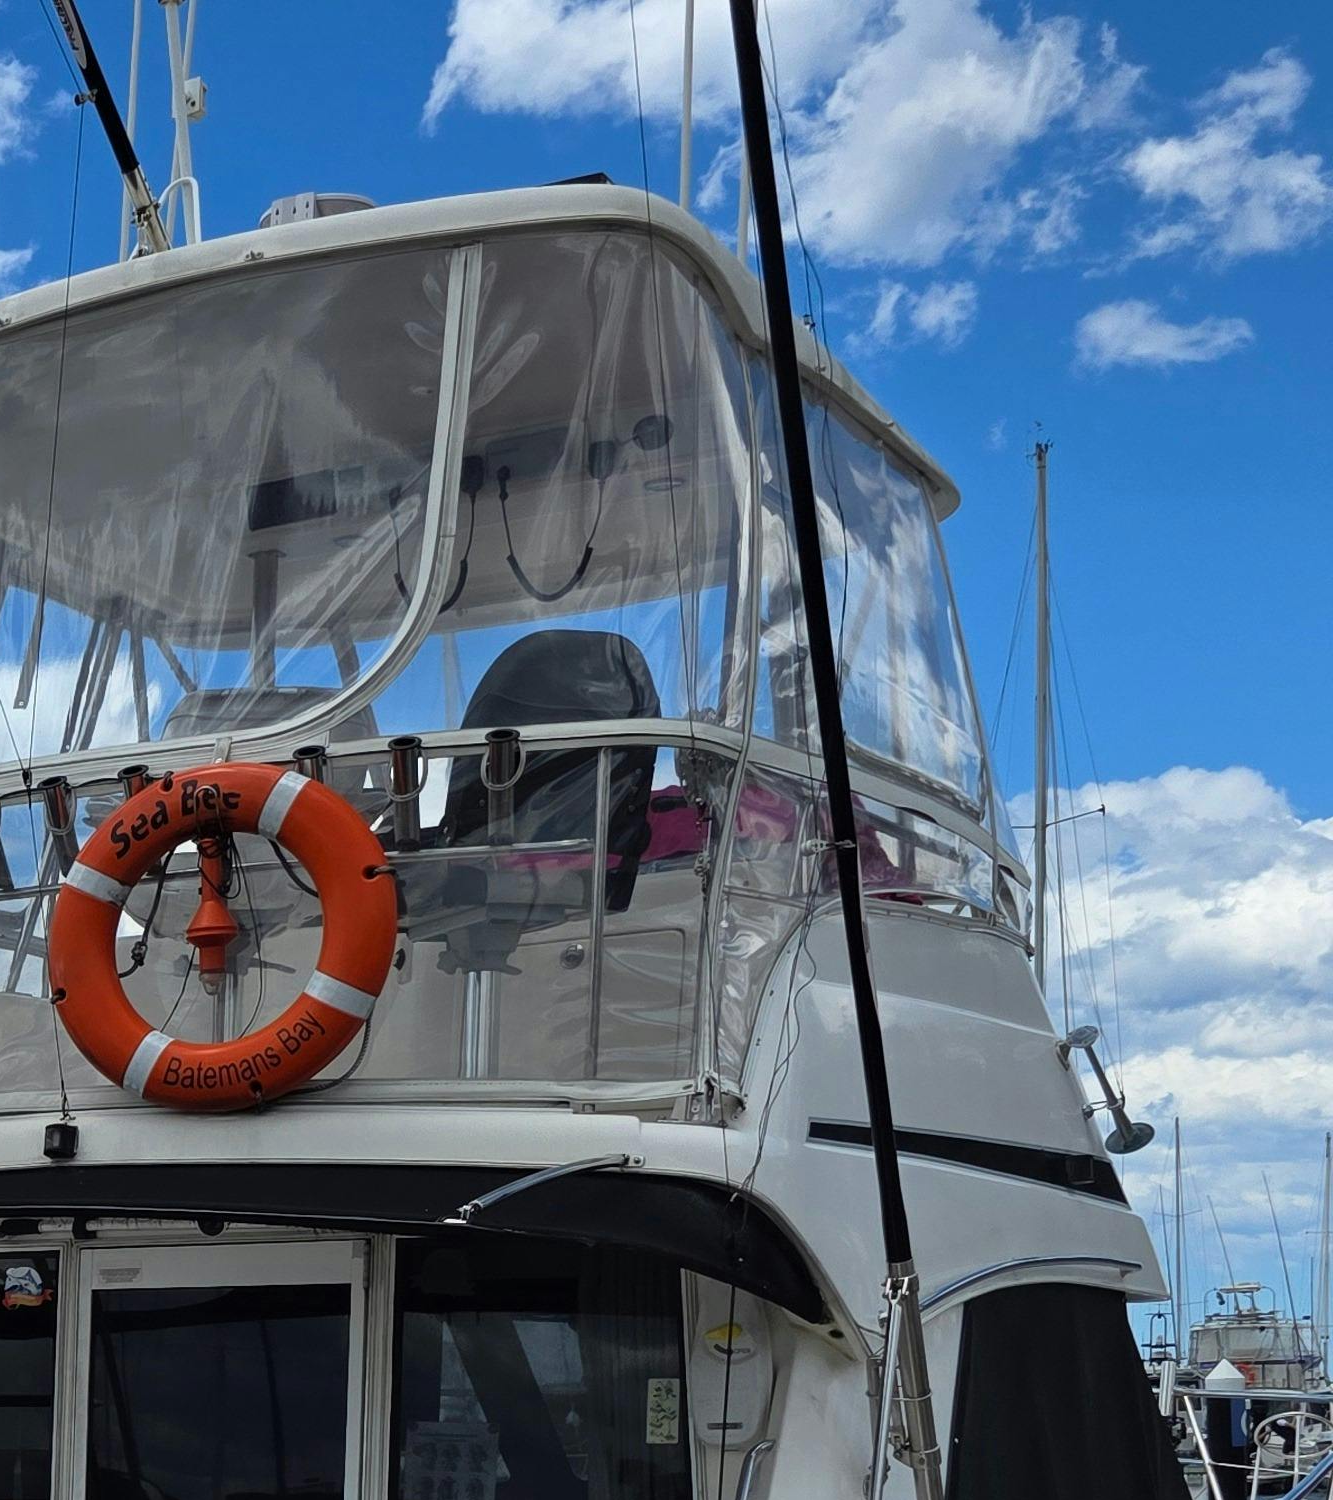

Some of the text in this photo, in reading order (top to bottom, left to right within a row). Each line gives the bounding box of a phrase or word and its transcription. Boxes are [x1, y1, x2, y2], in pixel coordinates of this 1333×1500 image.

[110, 800, 169, 860] Sea
[163, 1010, 326, 1090] Batemans Bay
